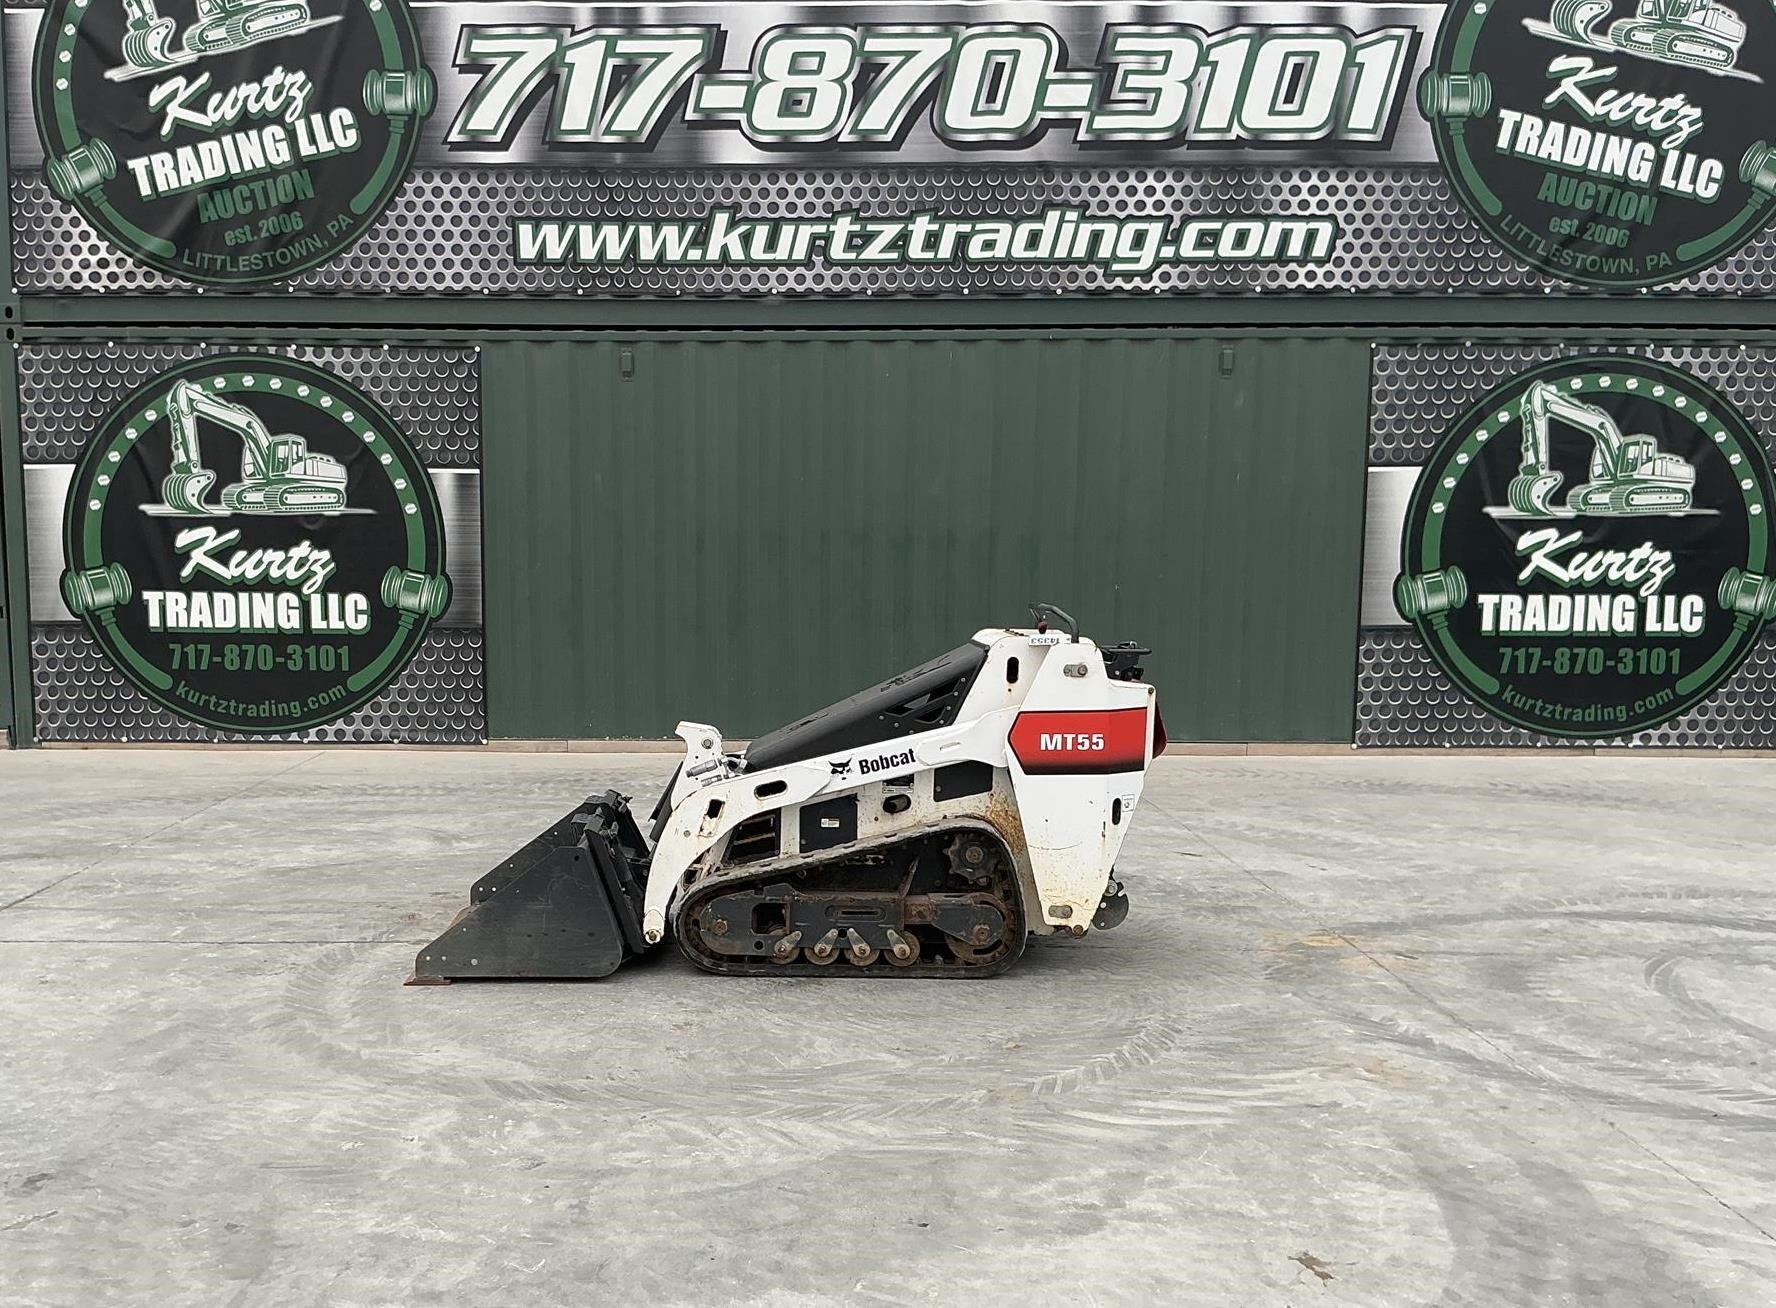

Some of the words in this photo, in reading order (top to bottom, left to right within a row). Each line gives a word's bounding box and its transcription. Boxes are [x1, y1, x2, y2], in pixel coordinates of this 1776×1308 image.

[148, 65, 313, 140] Kurtz
[456, 29, 1411, 140] 717-870-3101
[1544, 55, 1704, 149] Kurtz
[126, 125, 293, 199] TRADING
[294, 107, 361, 161] LLC
[1497, 109, 1655, 183] TRADING
[1660, 150, 1724, 202] LLC
[197, 168, 315, 223] AUCTION
[1537, 173, 1658, 226] AUCTION
[182, 234, 329, 273] LITTLESTOWN,
[326, 213, 354, 239] PA
[224, 224, 258, 247] est.
[258, 211, 304, 241] 2006
[515, 209, 1335, 272] www.kurtztrading.com
[1500, 214, 1639, 275] LITTLESTOWN,
[1646, 253, 1673, 271] PA
[1549, 216, 1580, 238] est.
[1585, 223, 1630, 249] 2006
[175, 526, 335, 593] Kurtz
[1516, 528, 1676, 597] Kurtz
[143, 592, 301, 631] TRADING
[309, 592, 370, 631] LLC
[1478, 594, 1636, 634] TRADING
[1643, 594, 1705, 634] LLC
[169, 643, 350, 672] 717-870-3101
[1499, 647, 1681, 675] 717-870-3101
[176, 680, 347, 718] kurtztrading.com
[1502, 685, 1674, 722] kurtztrading.com
[859, 748, 916, 775] Bobcat
[1040, 733, 1104, 751] MT55
